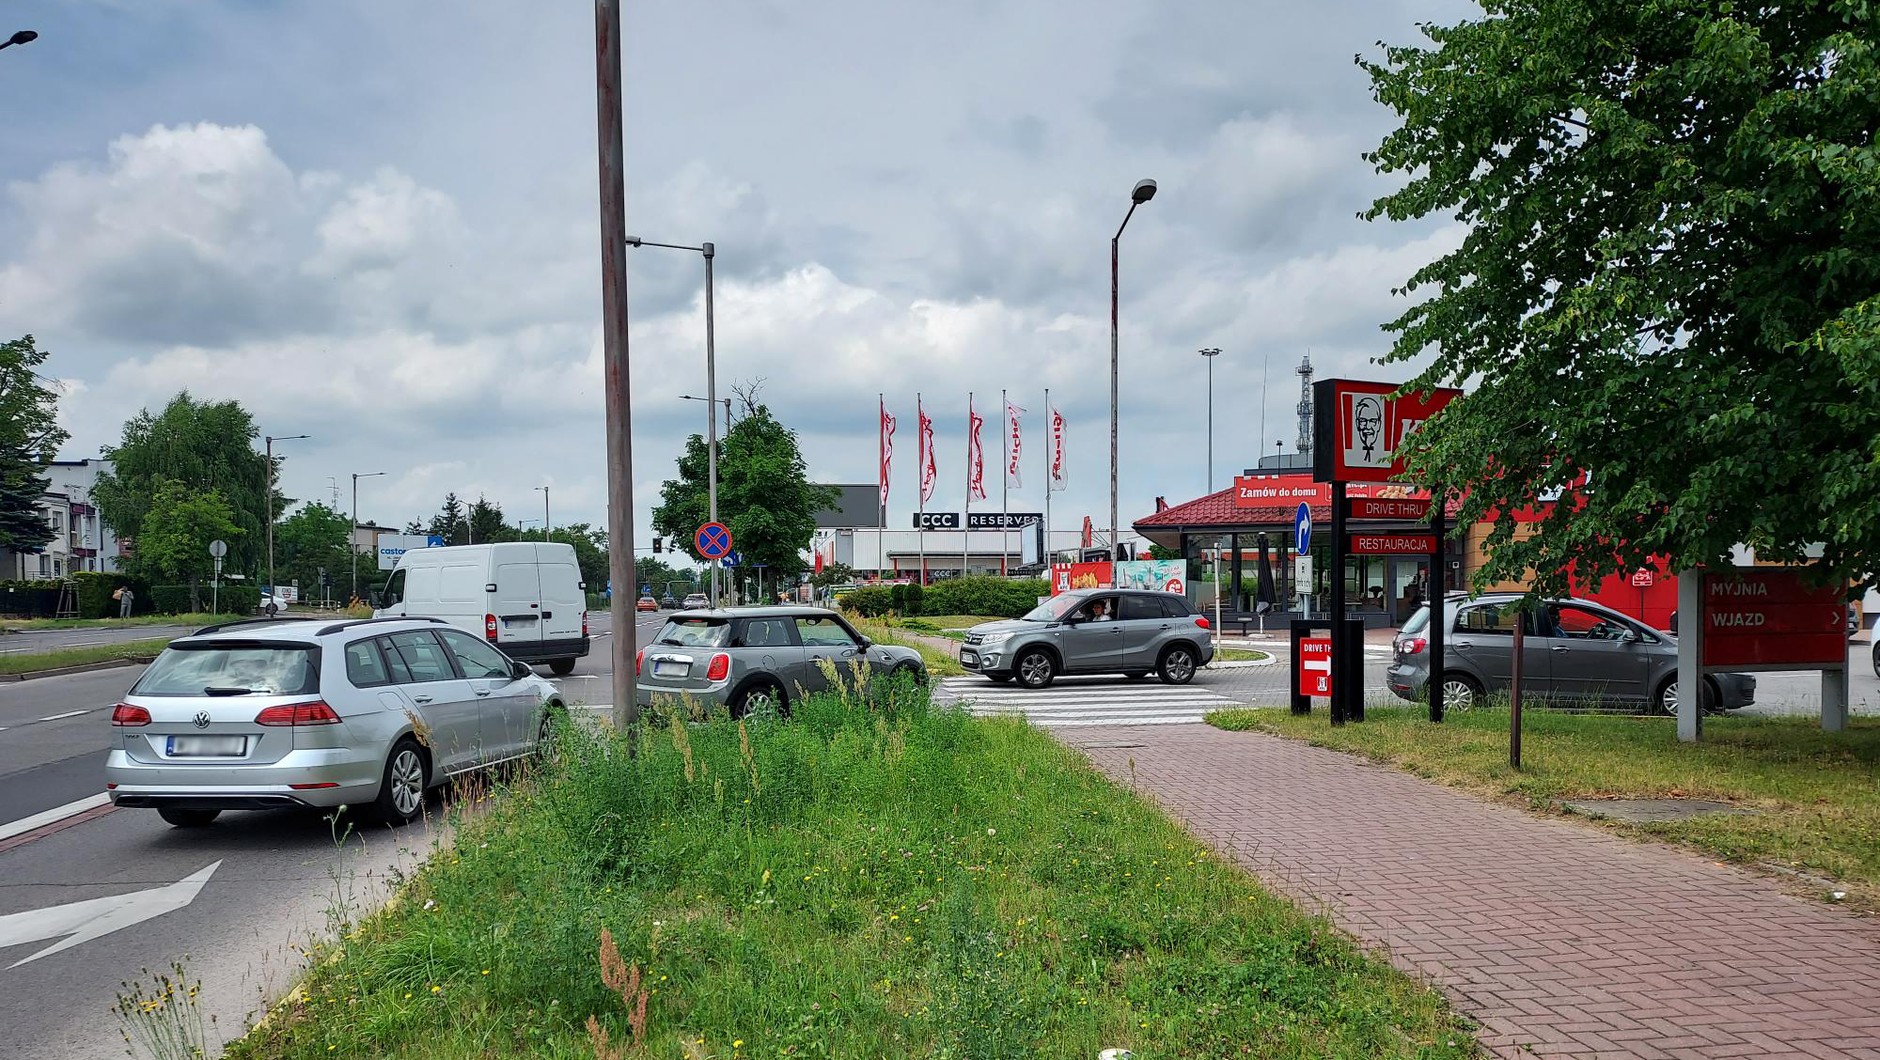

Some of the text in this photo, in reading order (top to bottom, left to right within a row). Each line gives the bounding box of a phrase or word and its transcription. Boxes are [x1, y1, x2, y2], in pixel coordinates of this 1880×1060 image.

[1240, 487, 1317, 498] Zamów do domu
[1366, 503, 1423, 514] DRIVE THRU
[921, 514, 952, 526] CCC
[1359, 538, 1428, 551] RESTAURACJA
[1711, 582, 1768, 597] MYJNIA
[1712, 612, 1765, 627] WJAZD
[1303, 643, 1323, 652] DRIVE
